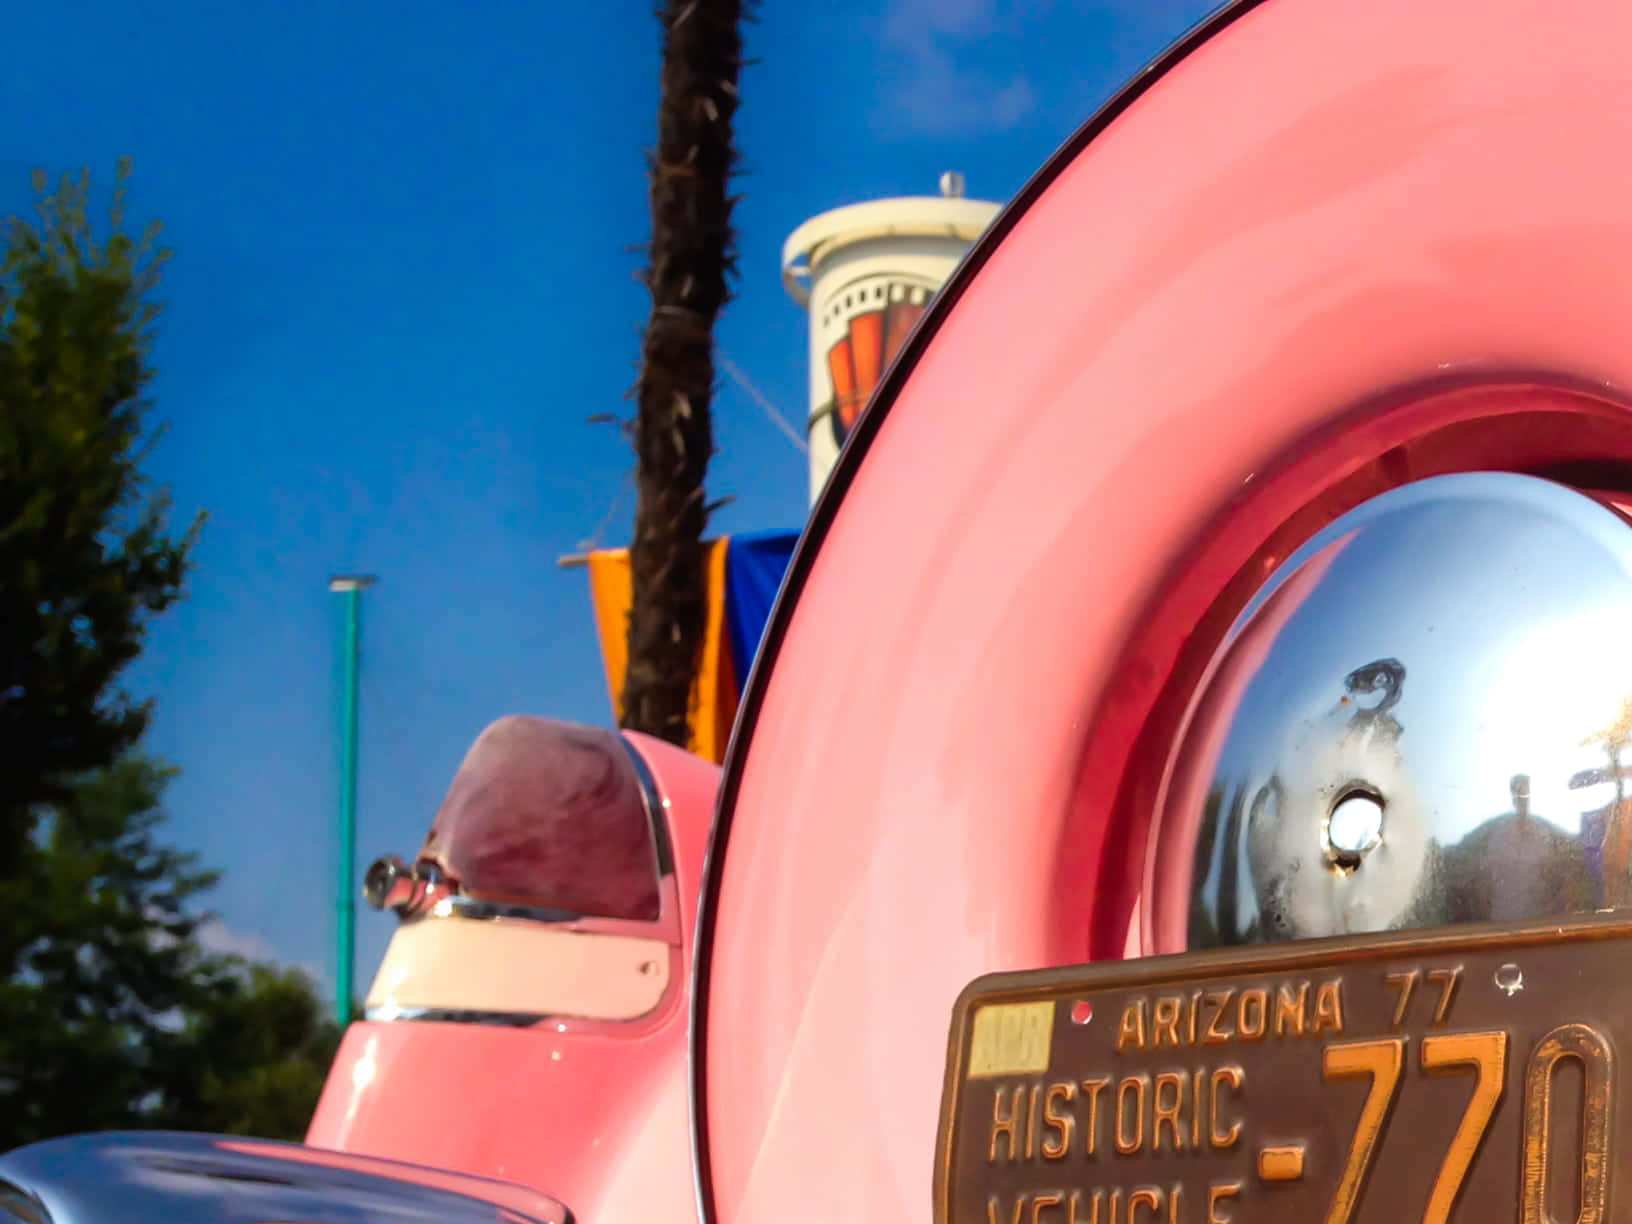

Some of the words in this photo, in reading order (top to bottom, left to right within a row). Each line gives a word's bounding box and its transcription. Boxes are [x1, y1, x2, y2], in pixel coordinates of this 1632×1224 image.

[1116, 976, 1343, 1048] ARIZONA
[1385, 965, 1464, 1026] 77
[989, 1066, 1244, 1160] HISTORIC
